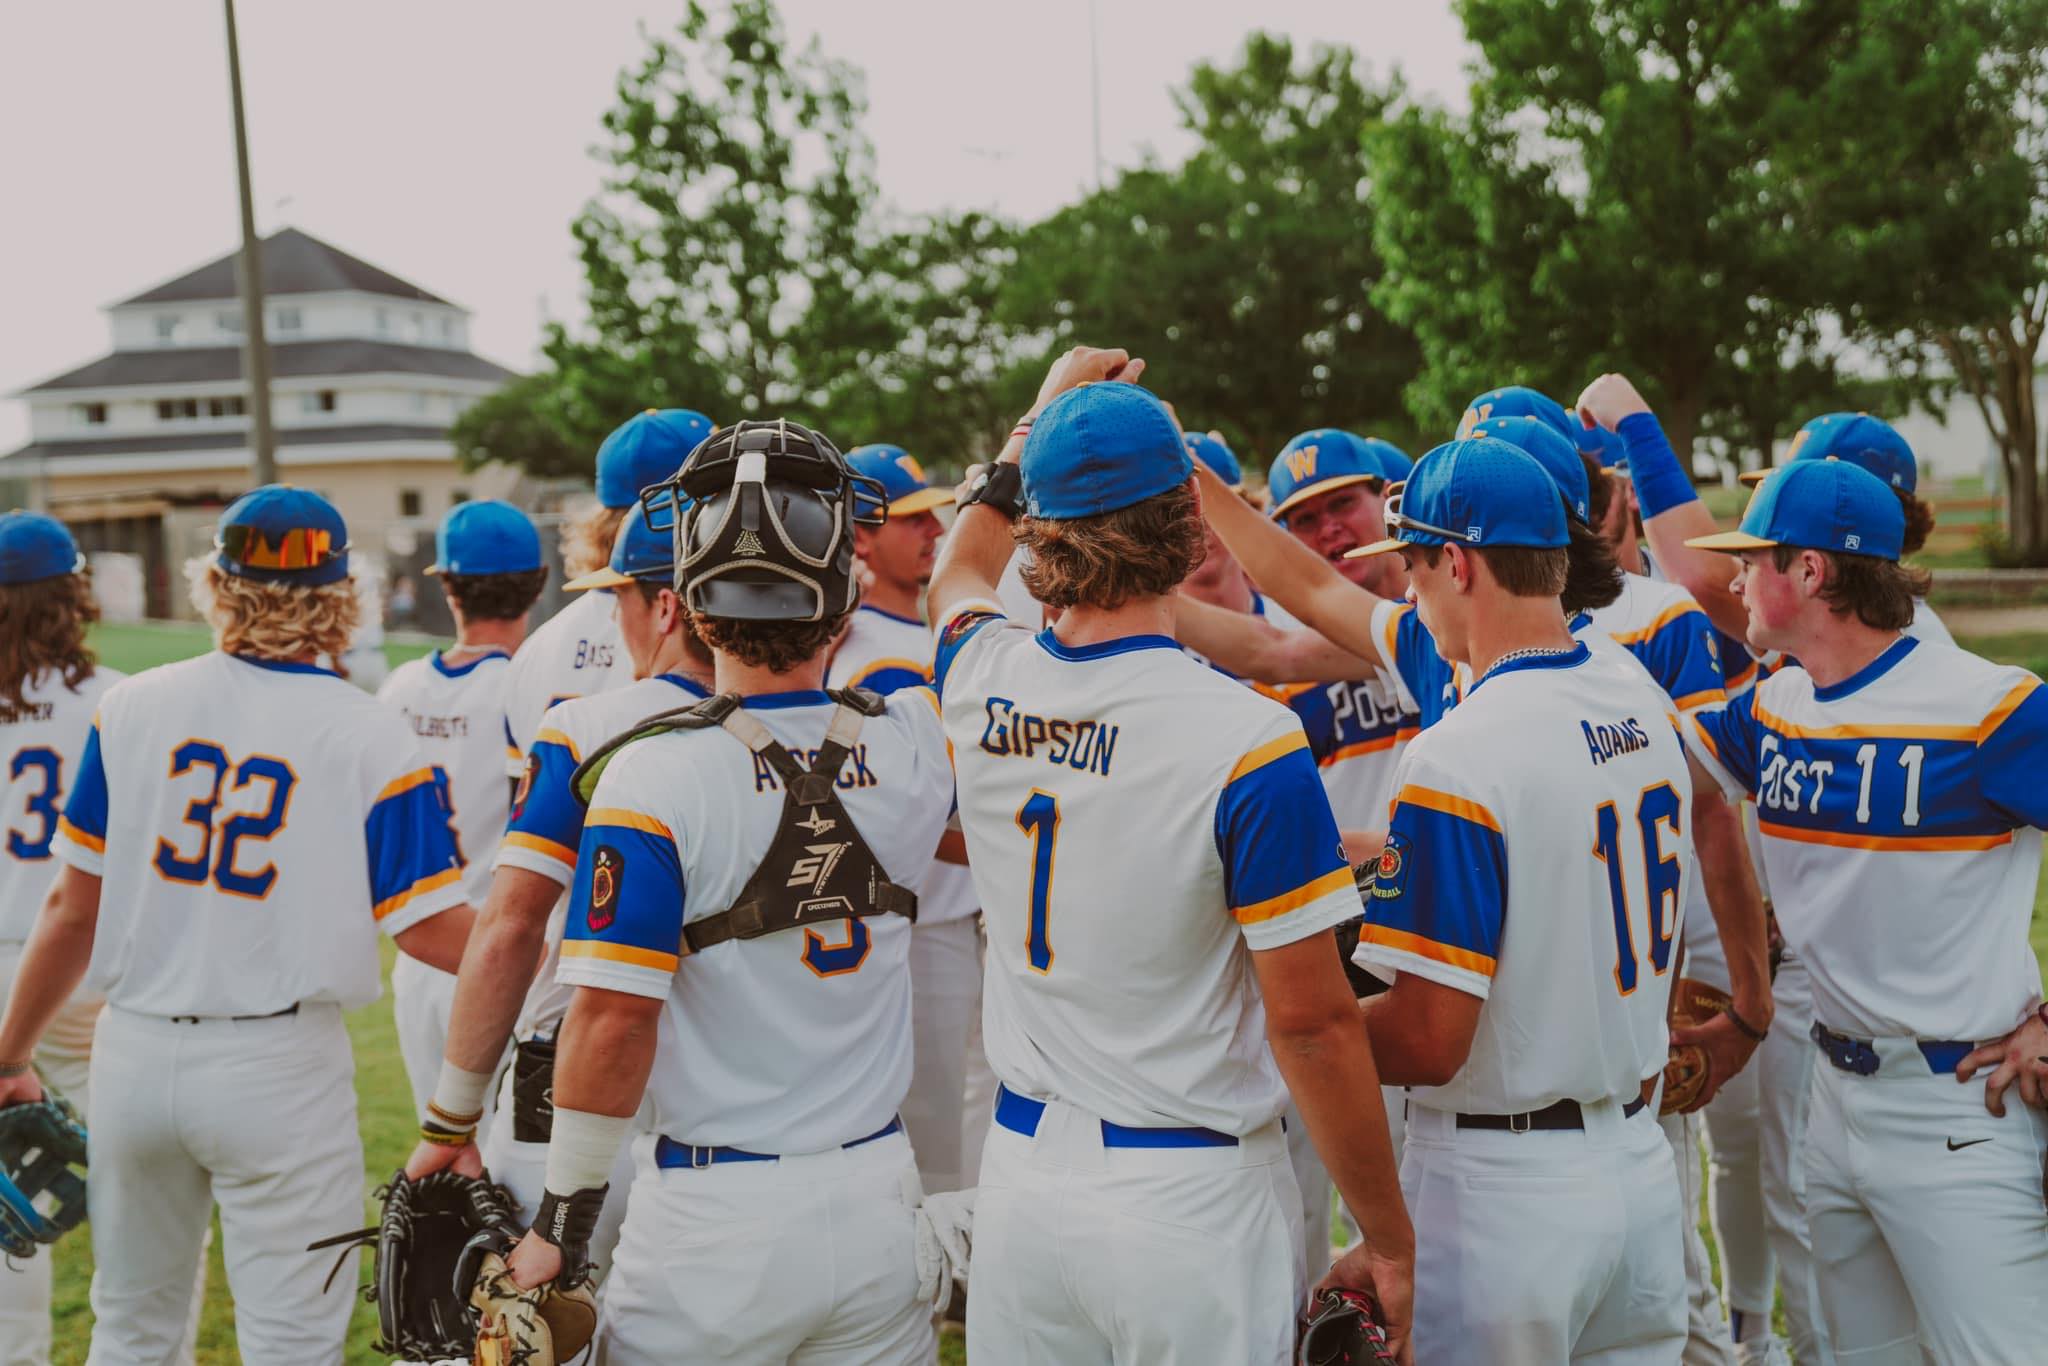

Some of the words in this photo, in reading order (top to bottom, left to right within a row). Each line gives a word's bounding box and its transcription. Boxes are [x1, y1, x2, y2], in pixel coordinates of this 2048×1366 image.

[1285, 445, 1319, 483] W
[979, 696, 1118, 777] GIPSON
[1581, 717, 1650, 766] ADAMS
[152, 737, 300, 901] 32
[1855, 743, 1925, 827] 11
[1015, 786, 1062, 976] 1
[1591, 779, 1683, 997] 16
